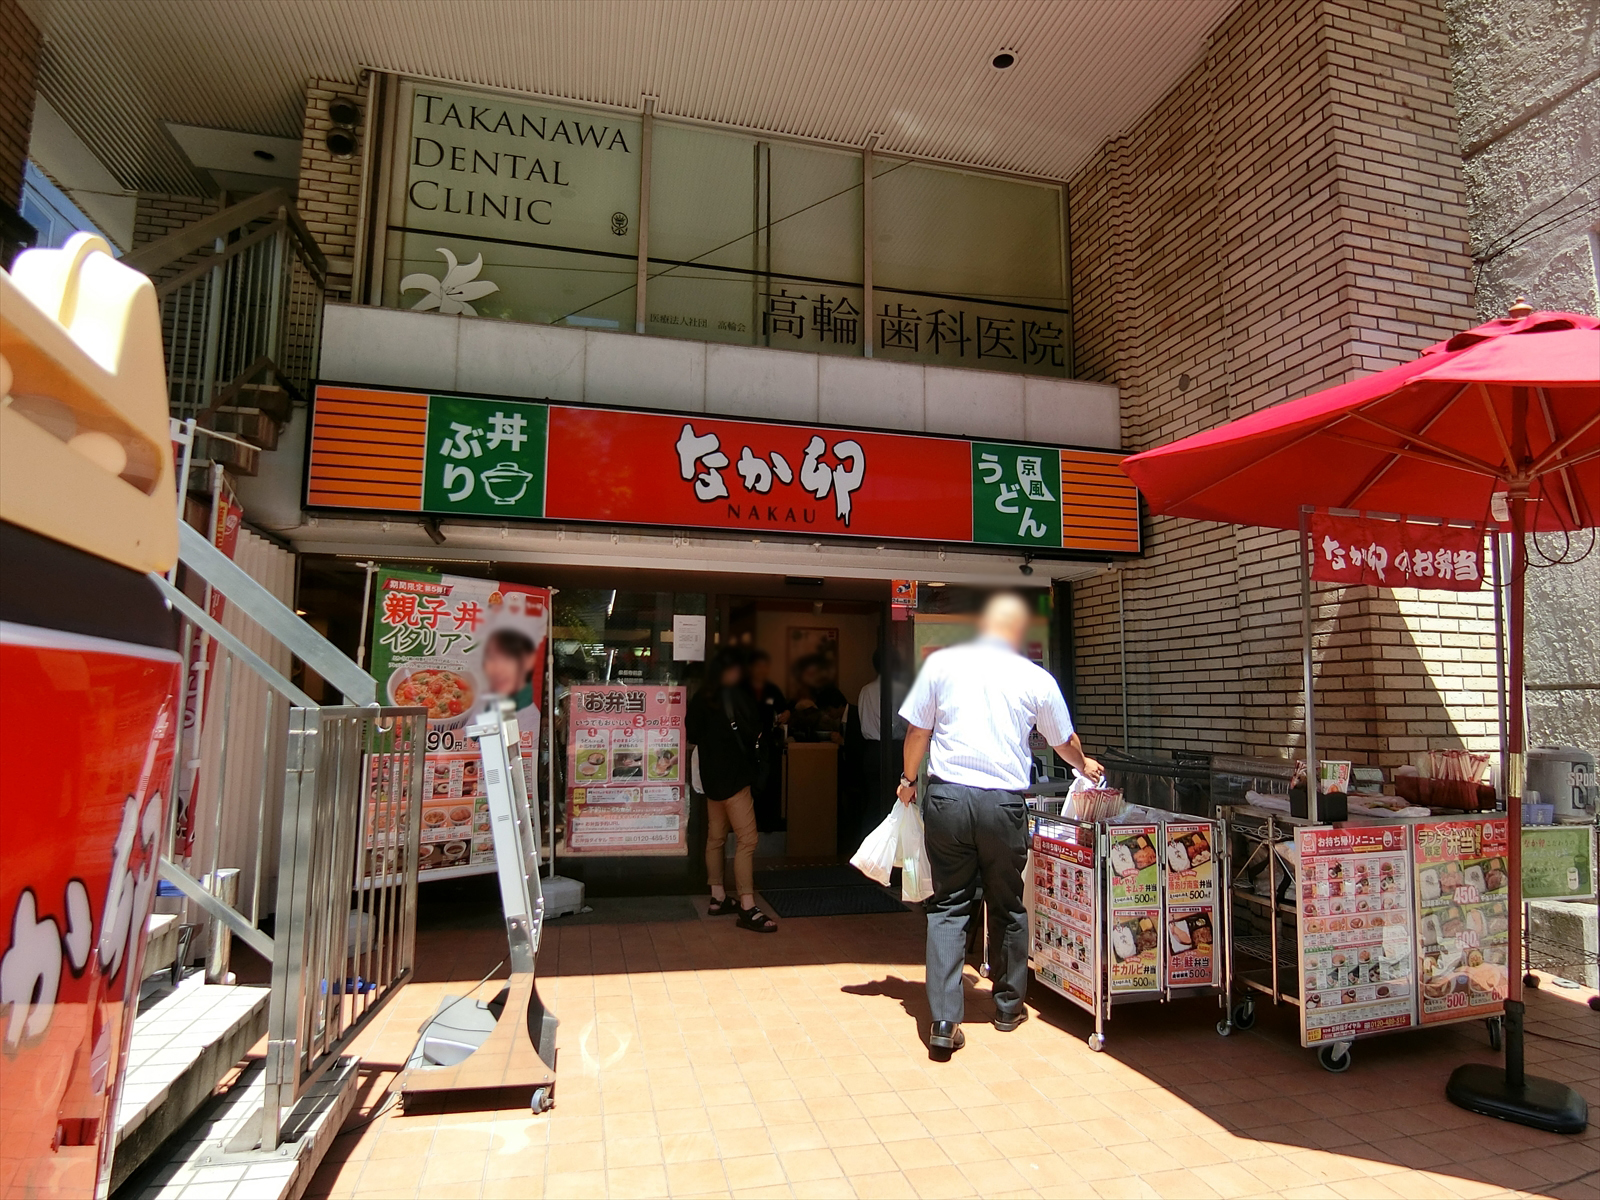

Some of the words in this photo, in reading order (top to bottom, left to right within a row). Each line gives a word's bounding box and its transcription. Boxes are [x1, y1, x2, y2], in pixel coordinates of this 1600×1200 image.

[416, 93, 632, 154] TAKANAWA
[412, 136, 570, 187] DENTAL
[408, 179, 553, 226] CLINIC
[650, 313, 708, 328] 医療法人社団
[717, 320, 746, 332] 高輪会
[675, 422, 866, 528] なか卯
[977, 451, 1047, 539] うどん
[1020, 457, 1046, 499] 京風
[727, 503, 816, 525] NAKAU
[1321, 534, 1479, 583] なか卯のお弁当
[381, 591, 486, 633] 親子丼
[380, 625, 480, 656] イタリアン
[583, 690, 646, 713] お弁当
[1317, 835, 1383, 848] お持ち帰りメニュー
